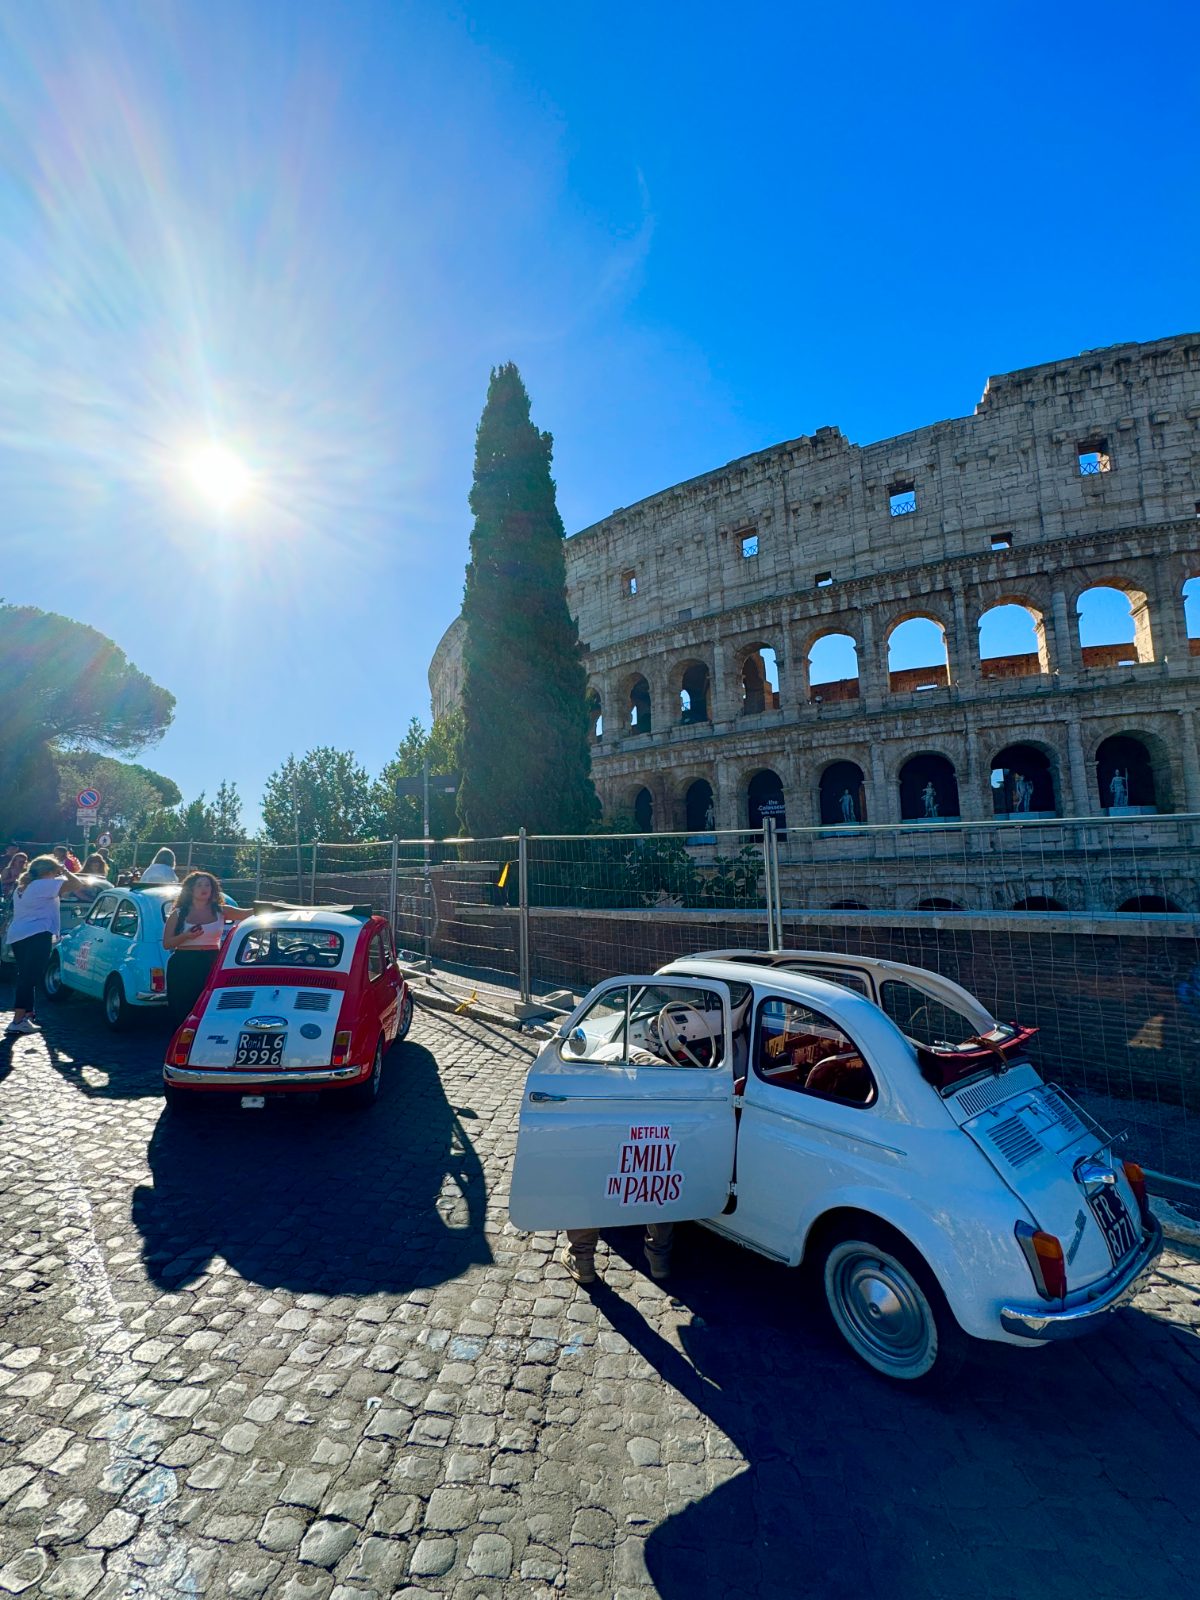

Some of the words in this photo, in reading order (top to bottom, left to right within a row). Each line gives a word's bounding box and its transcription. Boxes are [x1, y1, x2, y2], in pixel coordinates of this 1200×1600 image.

[236, 1049, 281, 1065] 9996
[630, 1126, 670, 1140] NETFLIX
[620, 1144, 677, 1174] EMILY
[607, 1177, 622, 1195] IN
[623, 1174, 682, 1206] PARIS
